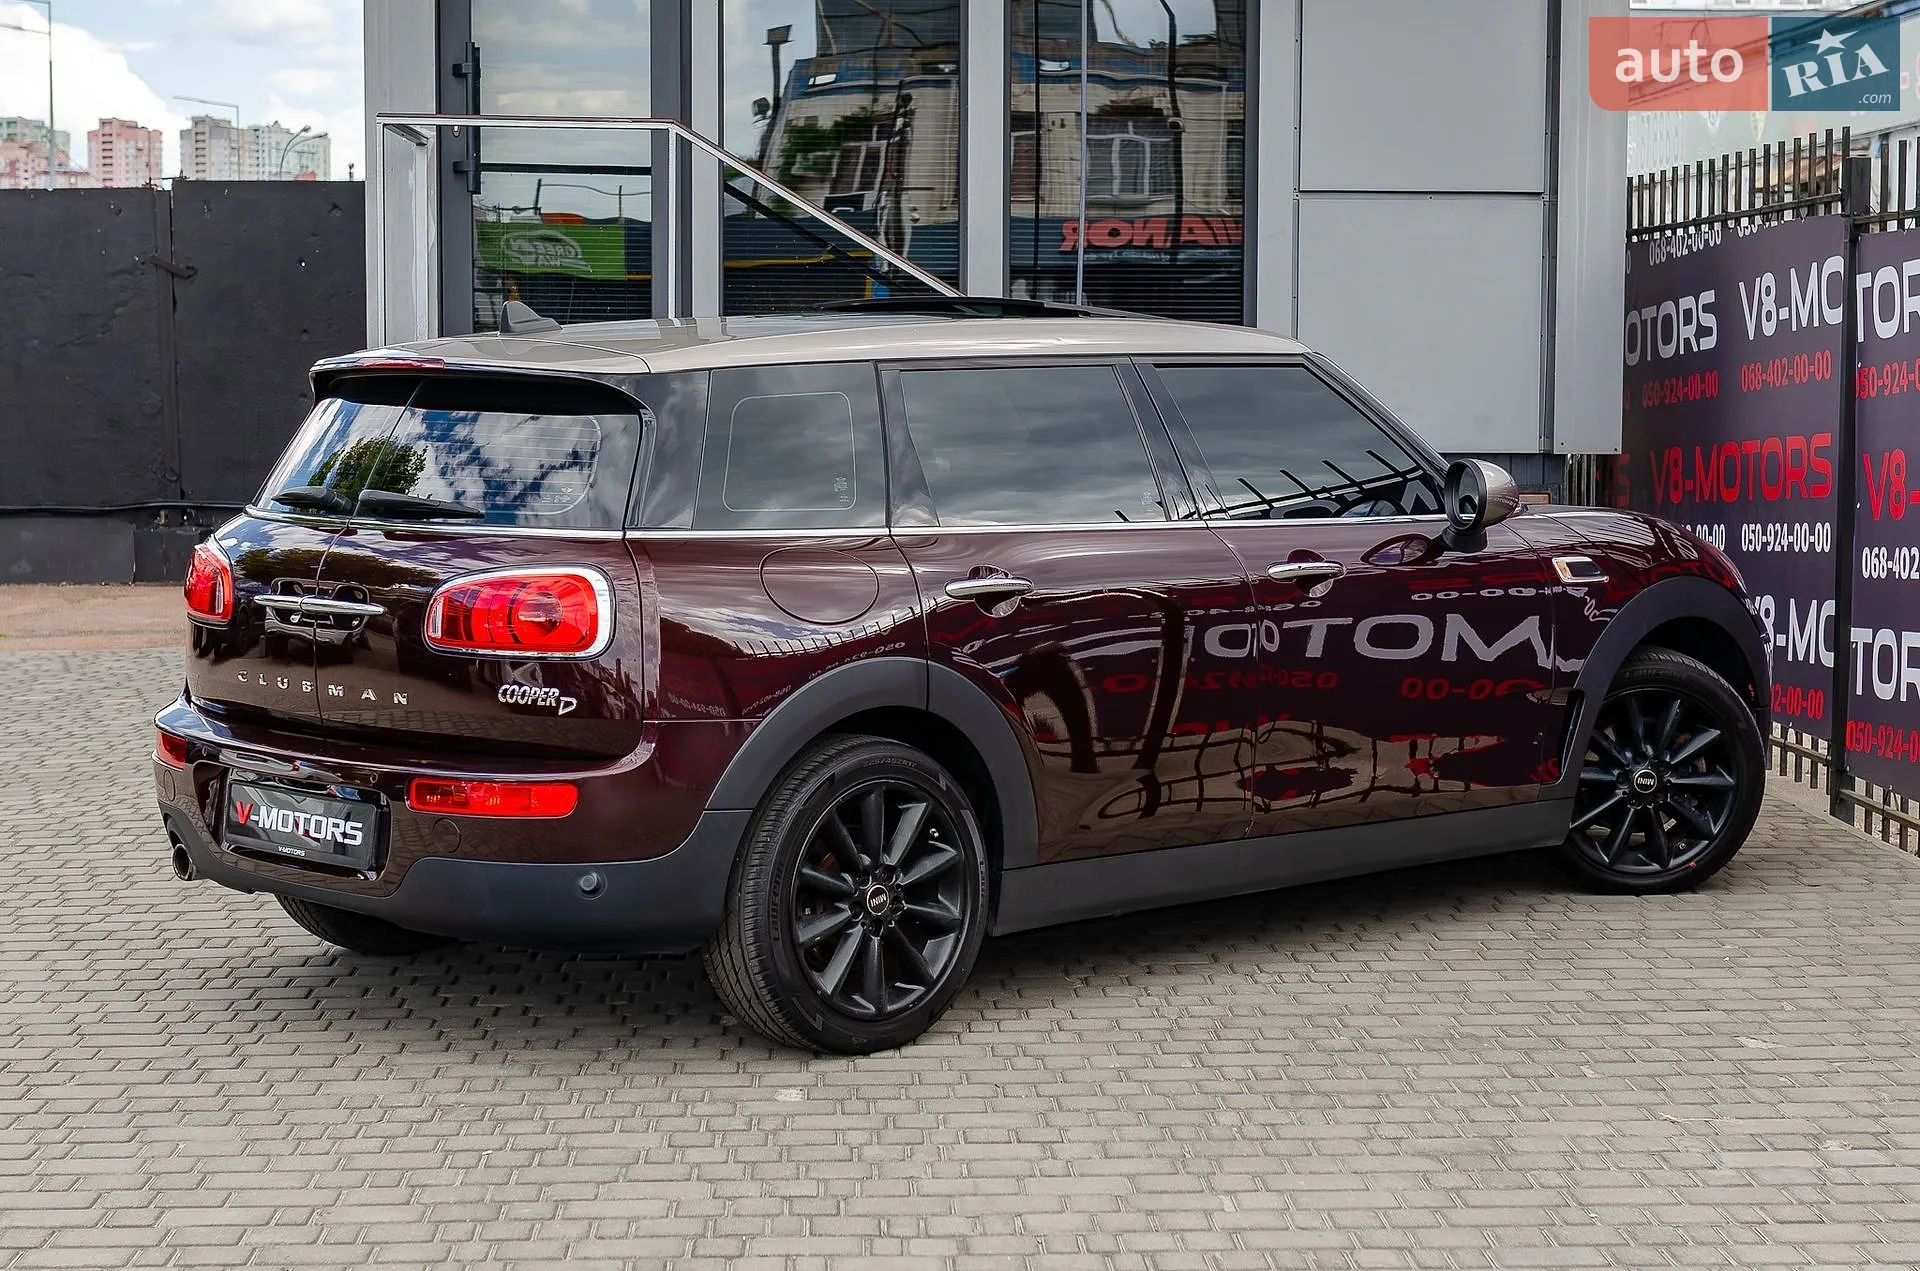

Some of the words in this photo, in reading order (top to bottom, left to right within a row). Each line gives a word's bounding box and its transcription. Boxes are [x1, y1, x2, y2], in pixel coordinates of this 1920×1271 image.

[1740, 350, 1832, 392] 068-402-00-00
[1651, 432, 1833, 506] V8-MOTORS
[1741, 522, 1831, 552] 050-924-00-00
[237, 670, 408, 705] CLUBMAN
[498, 684, 560, 706] COOPER
[558, 696, 577, 716] D
[235, 800, 363, 846] V-MOTORS
[278, 845, 306, 857] V-MOTORS
